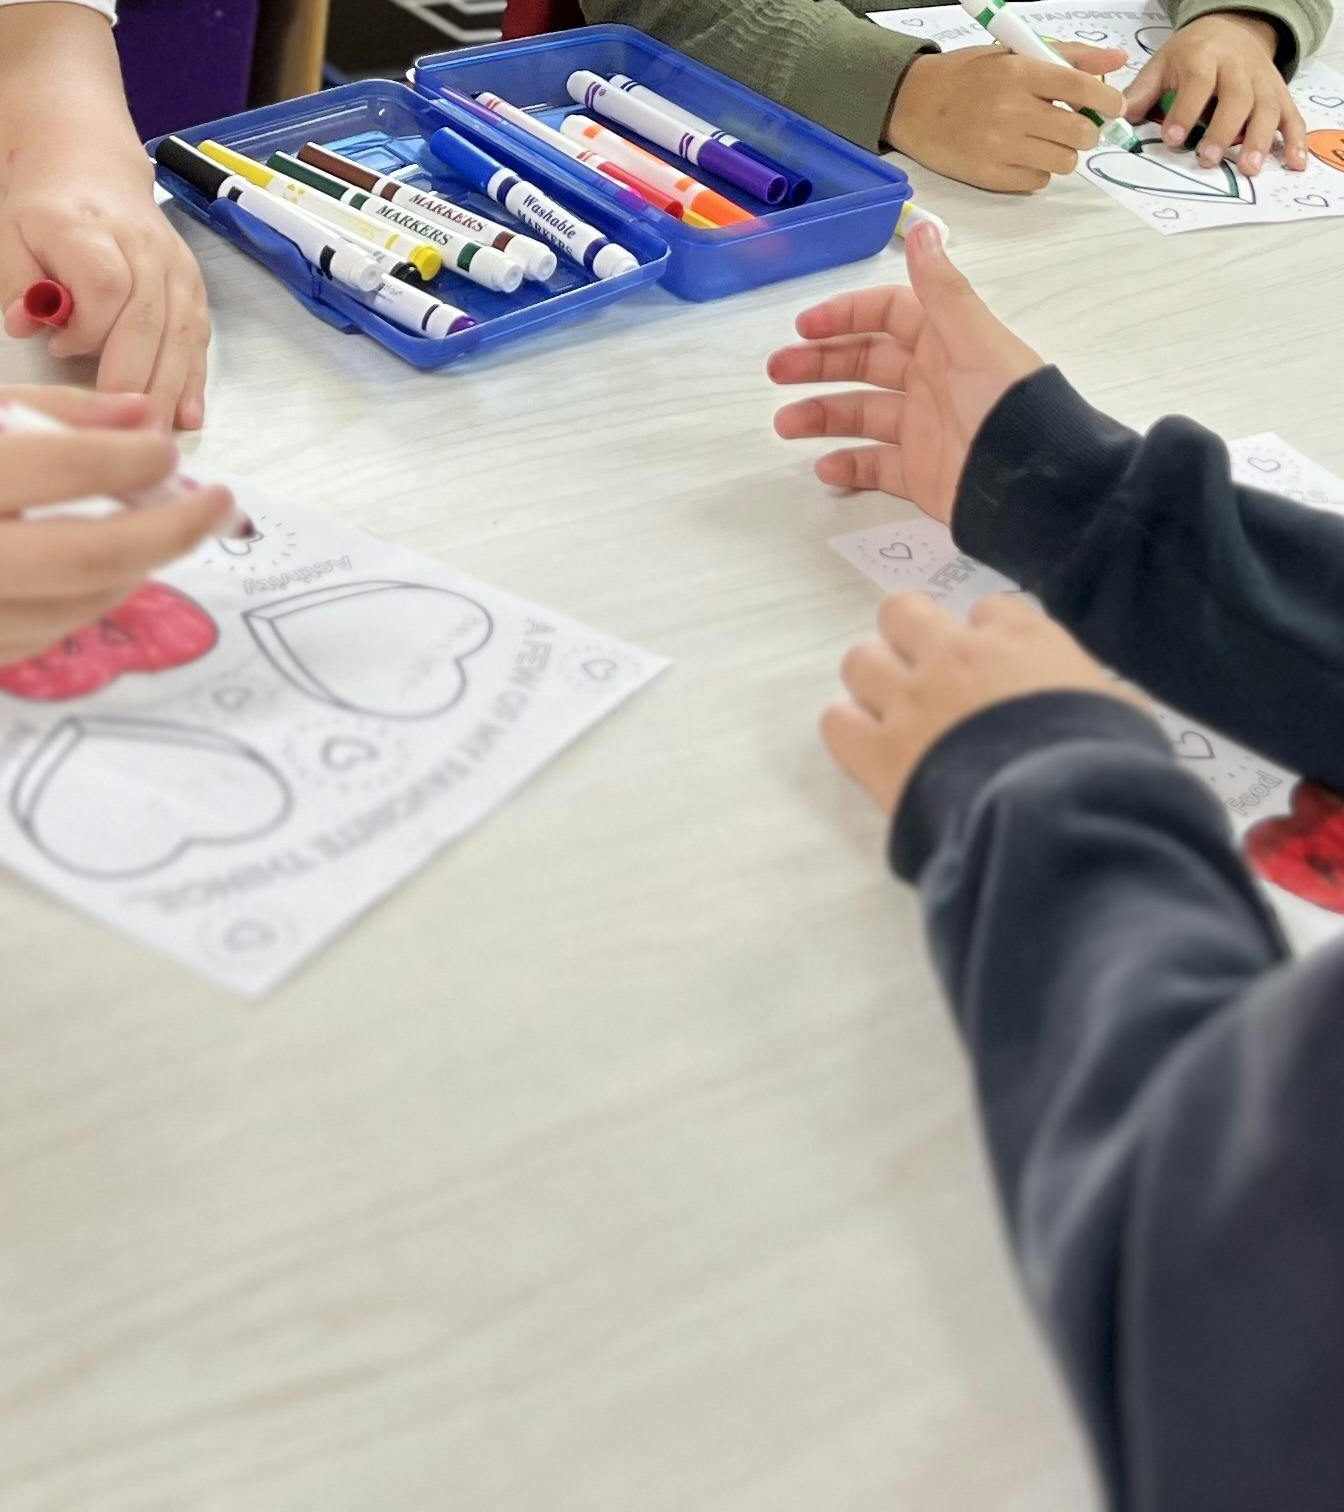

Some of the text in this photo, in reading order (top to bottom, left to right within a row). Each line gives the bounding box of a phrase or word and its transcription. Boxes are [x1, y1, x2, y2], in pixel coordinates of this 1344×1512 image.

[376, 204, 455, 246] MARKERS
[409, 192, 487, 233] MARKERS
[523, 194, 576, 239] Washable
[242, 554, 353, 596] Activity
[1224, 770, 1283, 817] Food
